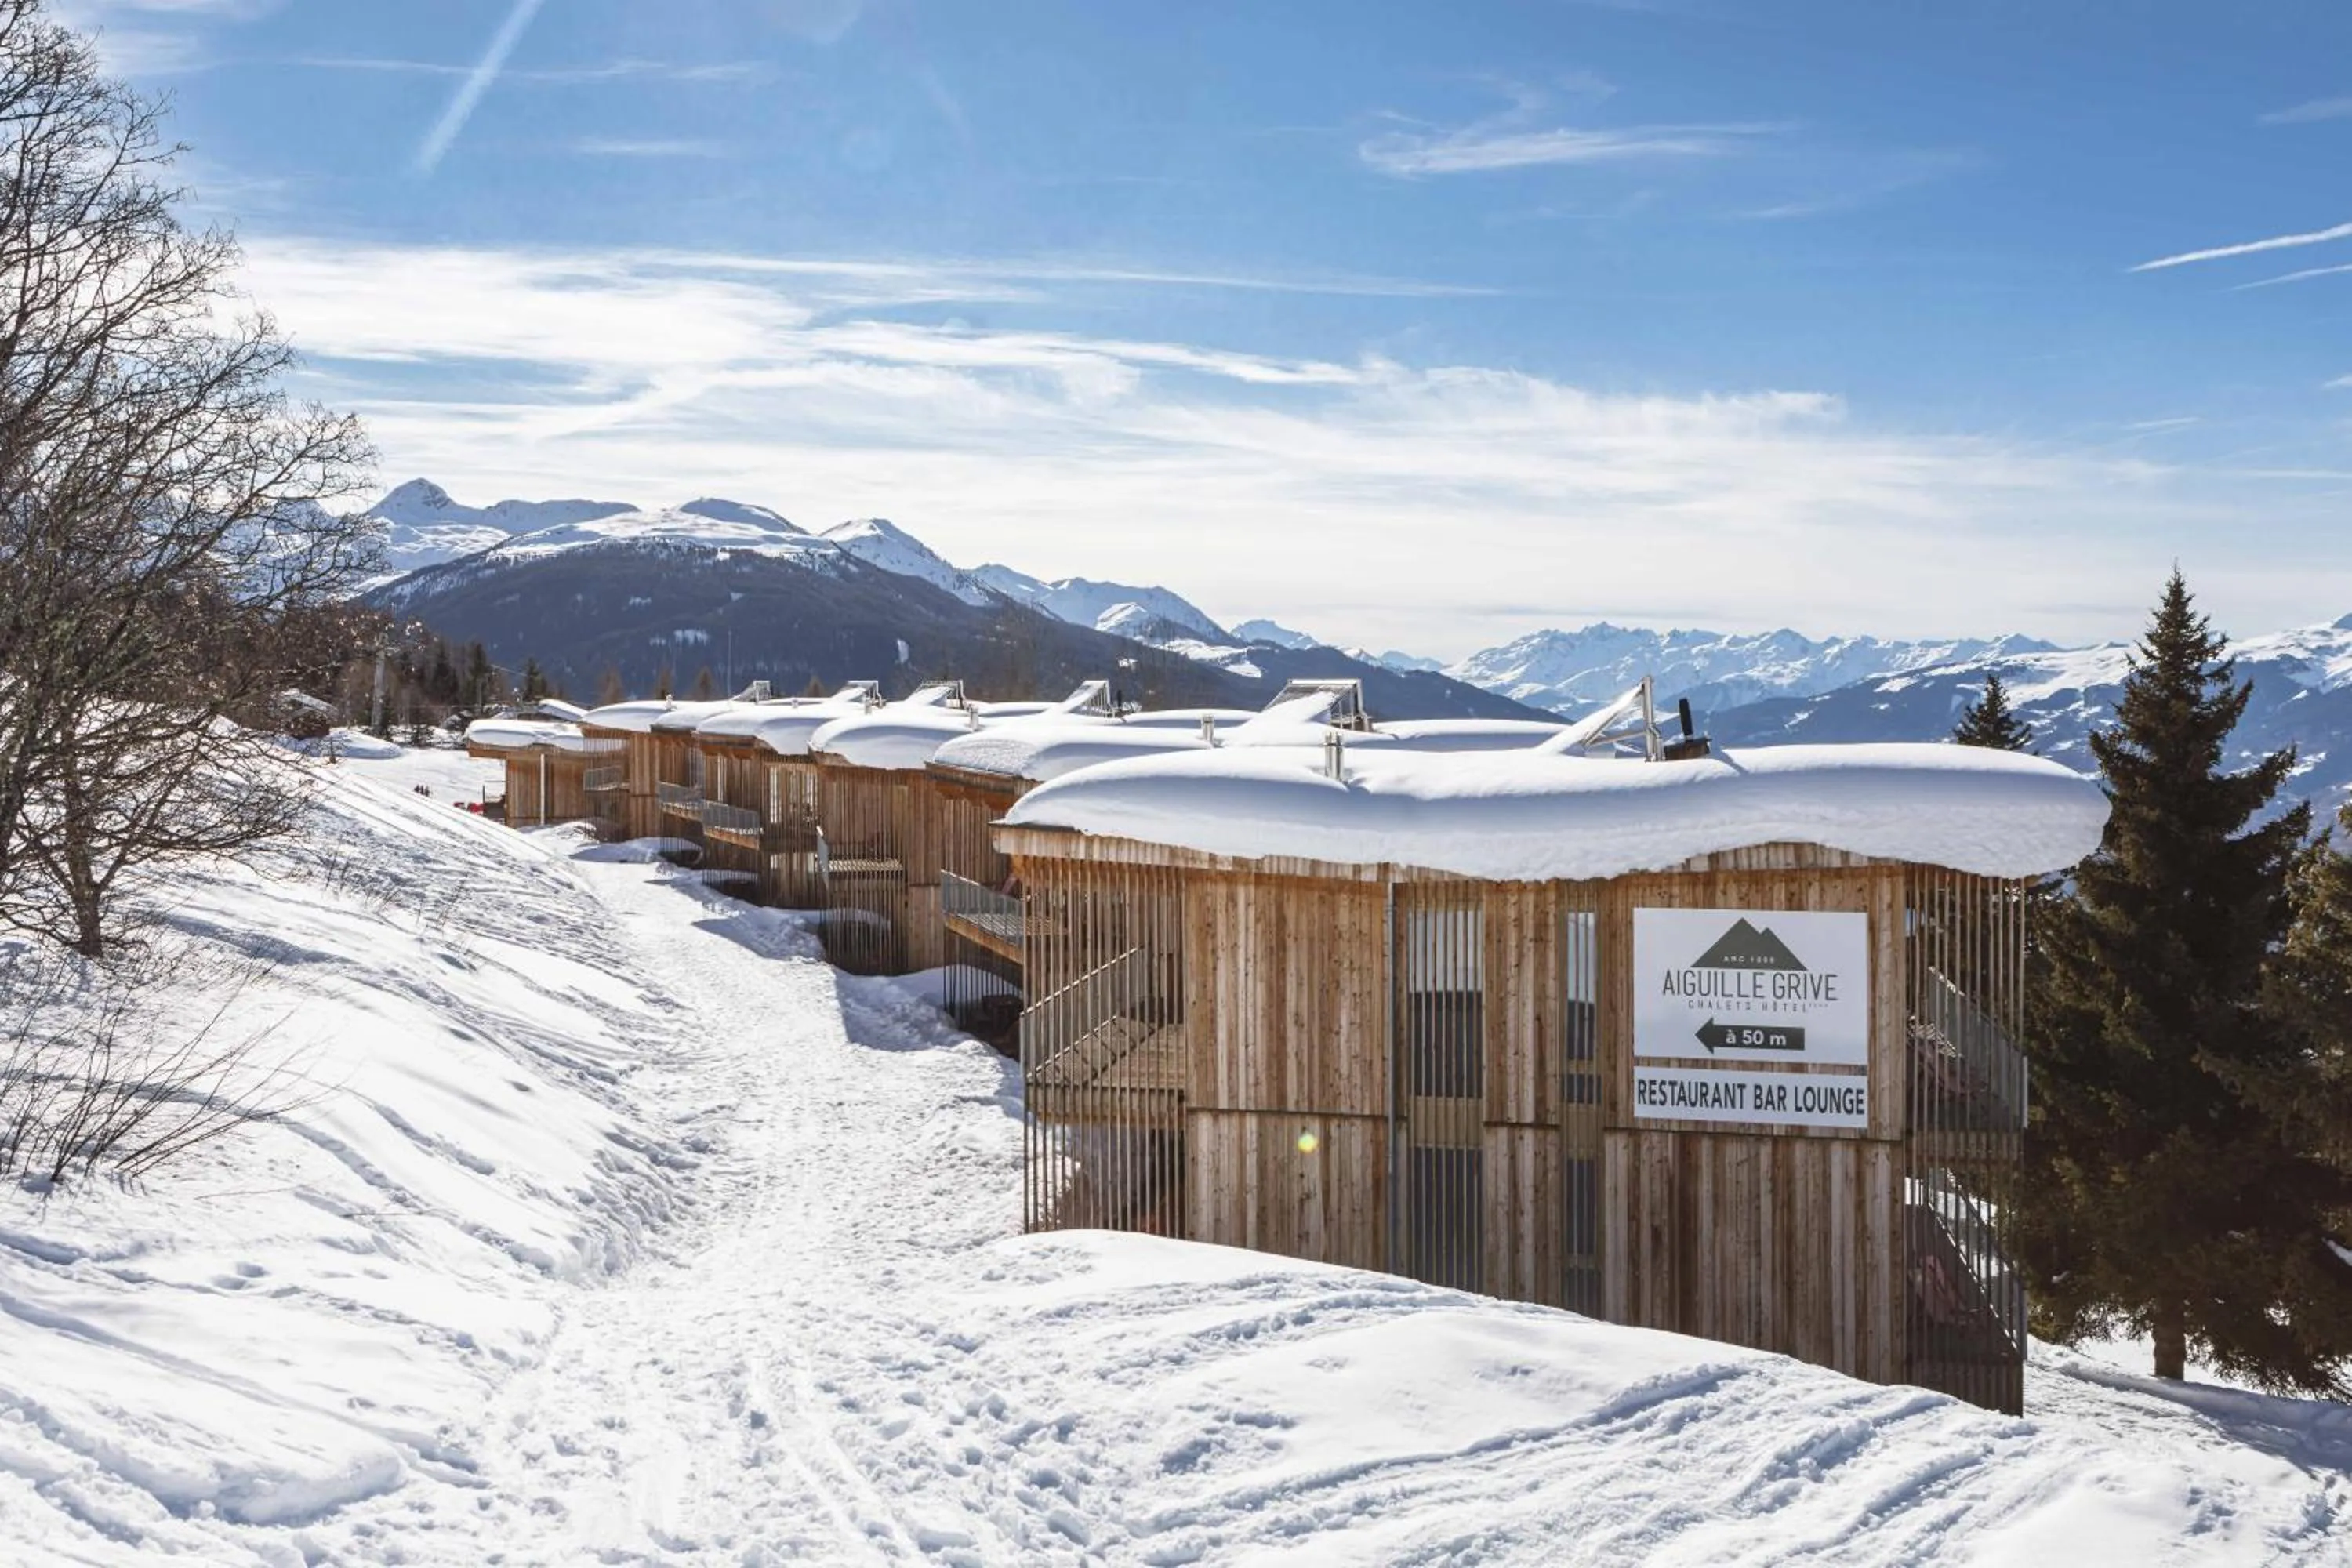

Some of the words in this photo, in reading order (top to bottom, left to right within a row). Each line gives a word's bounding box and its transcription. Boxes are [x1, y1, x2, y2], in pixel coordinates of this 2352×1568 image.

[1662, 969, 1766, 999] AIGUILLE
[1772, 973, 1839, 1001] GRIVE
[1688, 999, 1751, 1011] CHALETS
[1725, 1029, 1737, 1044] à
[1742, 1029, 1764, 1045] 50
[1769, 1034, 1787, 1046] m
[1637, 1079, 1747, 1109] RESTAURANT
[1753, 1084, 1788, 1112] BAR
[1794, 1086, 1865, 1115] LOUNGE
